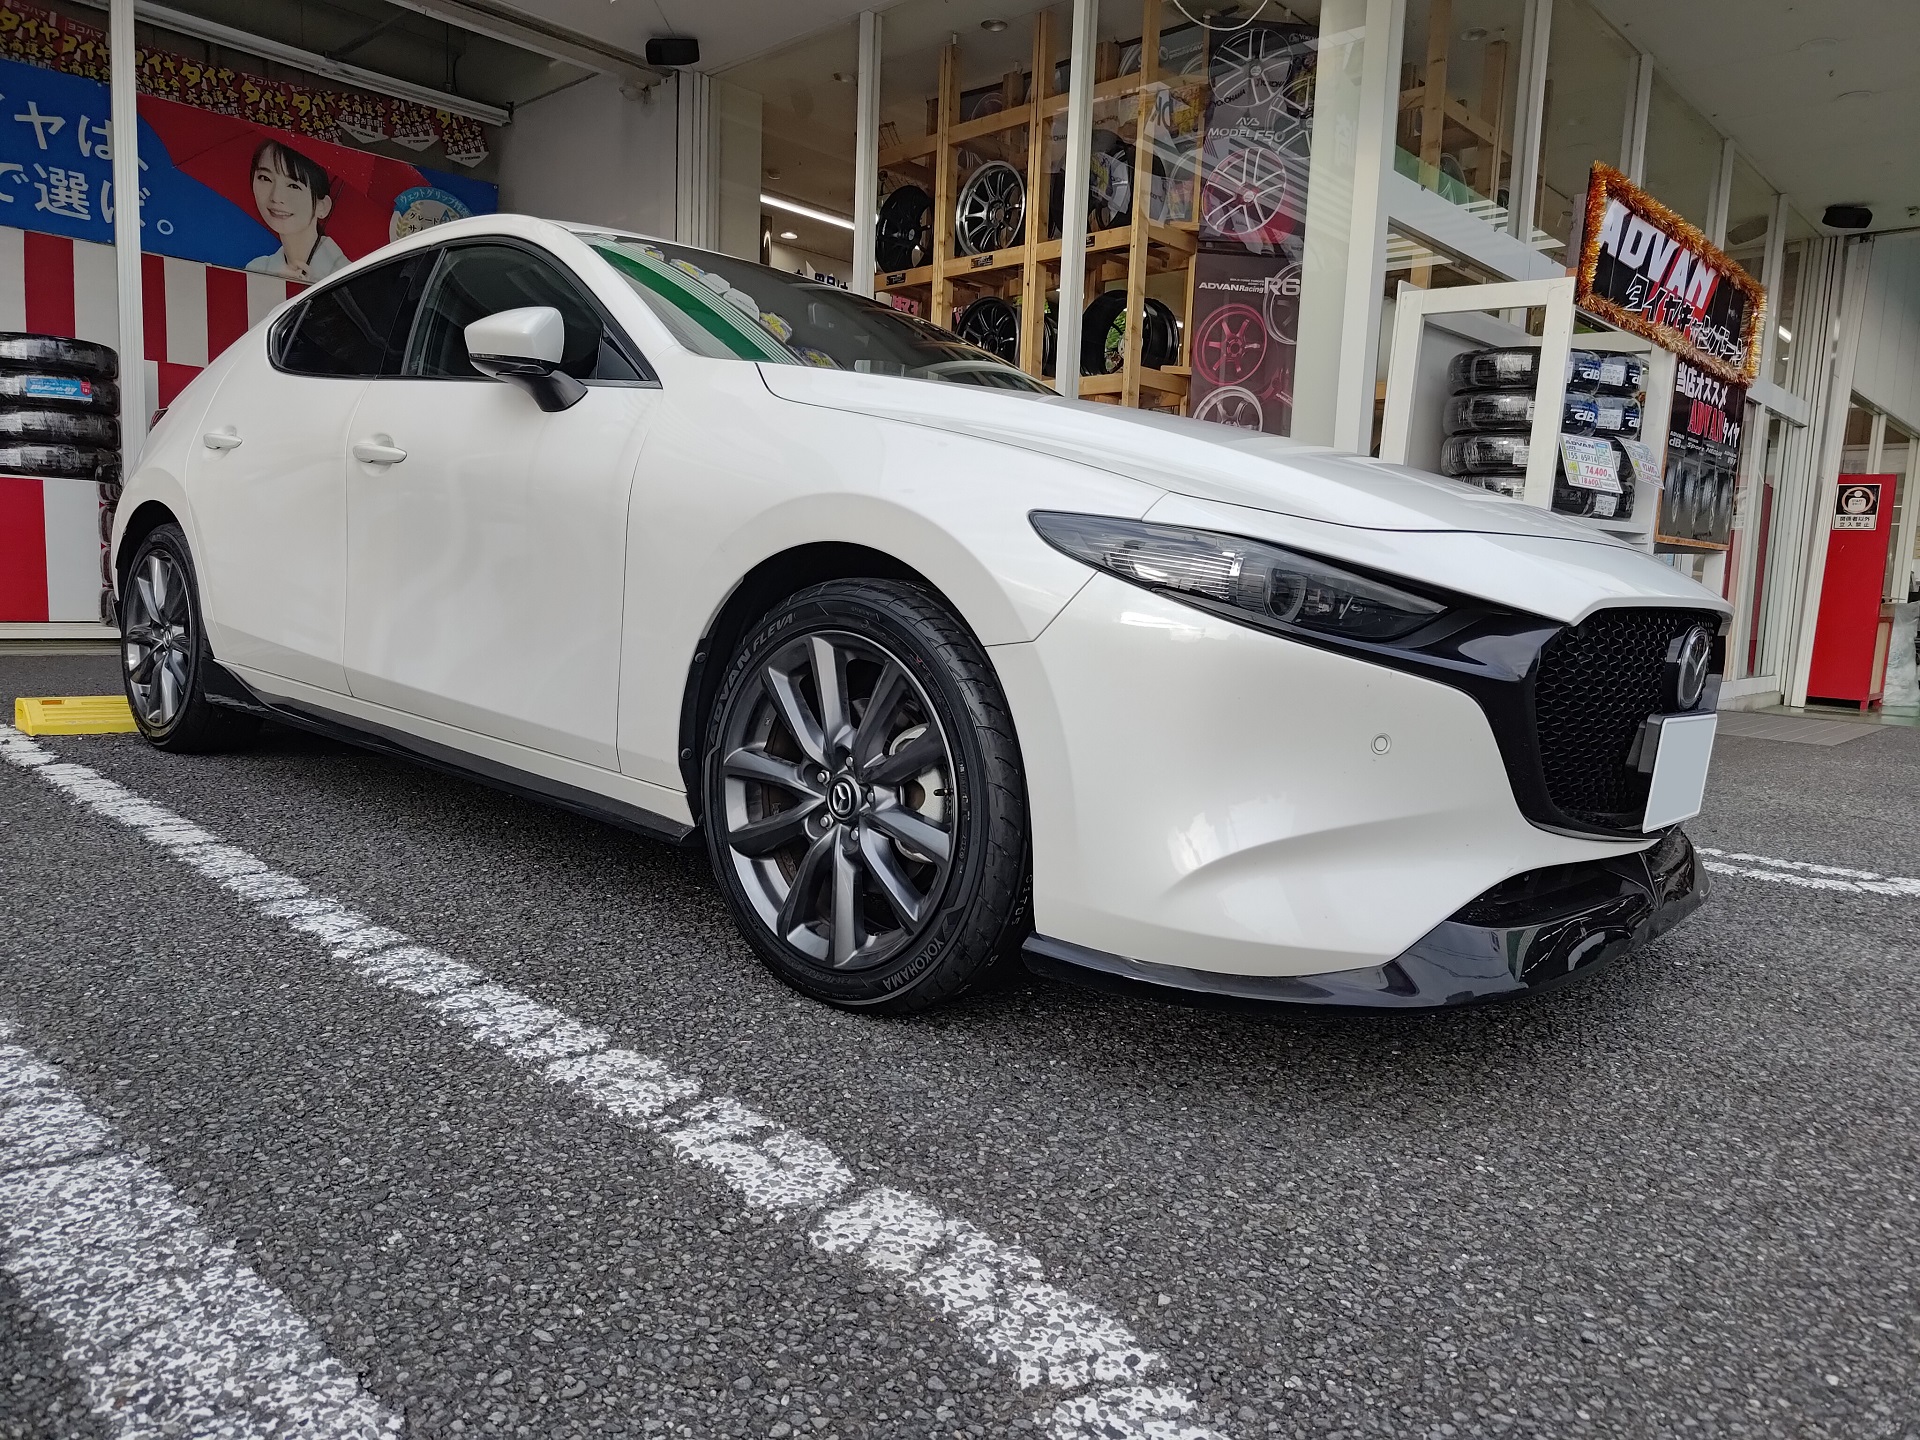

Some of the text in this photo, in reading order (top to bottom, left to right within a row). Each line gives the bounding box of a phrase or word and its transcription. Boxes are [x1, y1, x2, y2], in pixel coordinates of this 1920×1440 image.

[0, 6, 60, 44] タイヤ
[67, 22, 104, 39] ヨコハマ
[180, 62, 235, 88] タイヤ
[1208, 127, 1285, 142] MODEL F50
[409, 212, 439, 225] グレード
[1599, 199, 1719, 310] ADVAN
[1198, 281, 1239, 291] ADVAN
[1239, 285, 1264, 294] Racing
[1264, 277, 1300, 295] R6
[1582, 369, 1600, 380] dB
[1675, 361, 1729, 409] 当店オススメ
[1575, 410, 1595, 422] dB
[1566, 440, 1595, 449] ADVAN
[1669, 437, 1682, 448] dB
[1686, 441, 1705, 452] Sport
[709, 613, 793, 746] ADVAN FLEVA
[882, 937, 945, 991] YOKOHAMA
